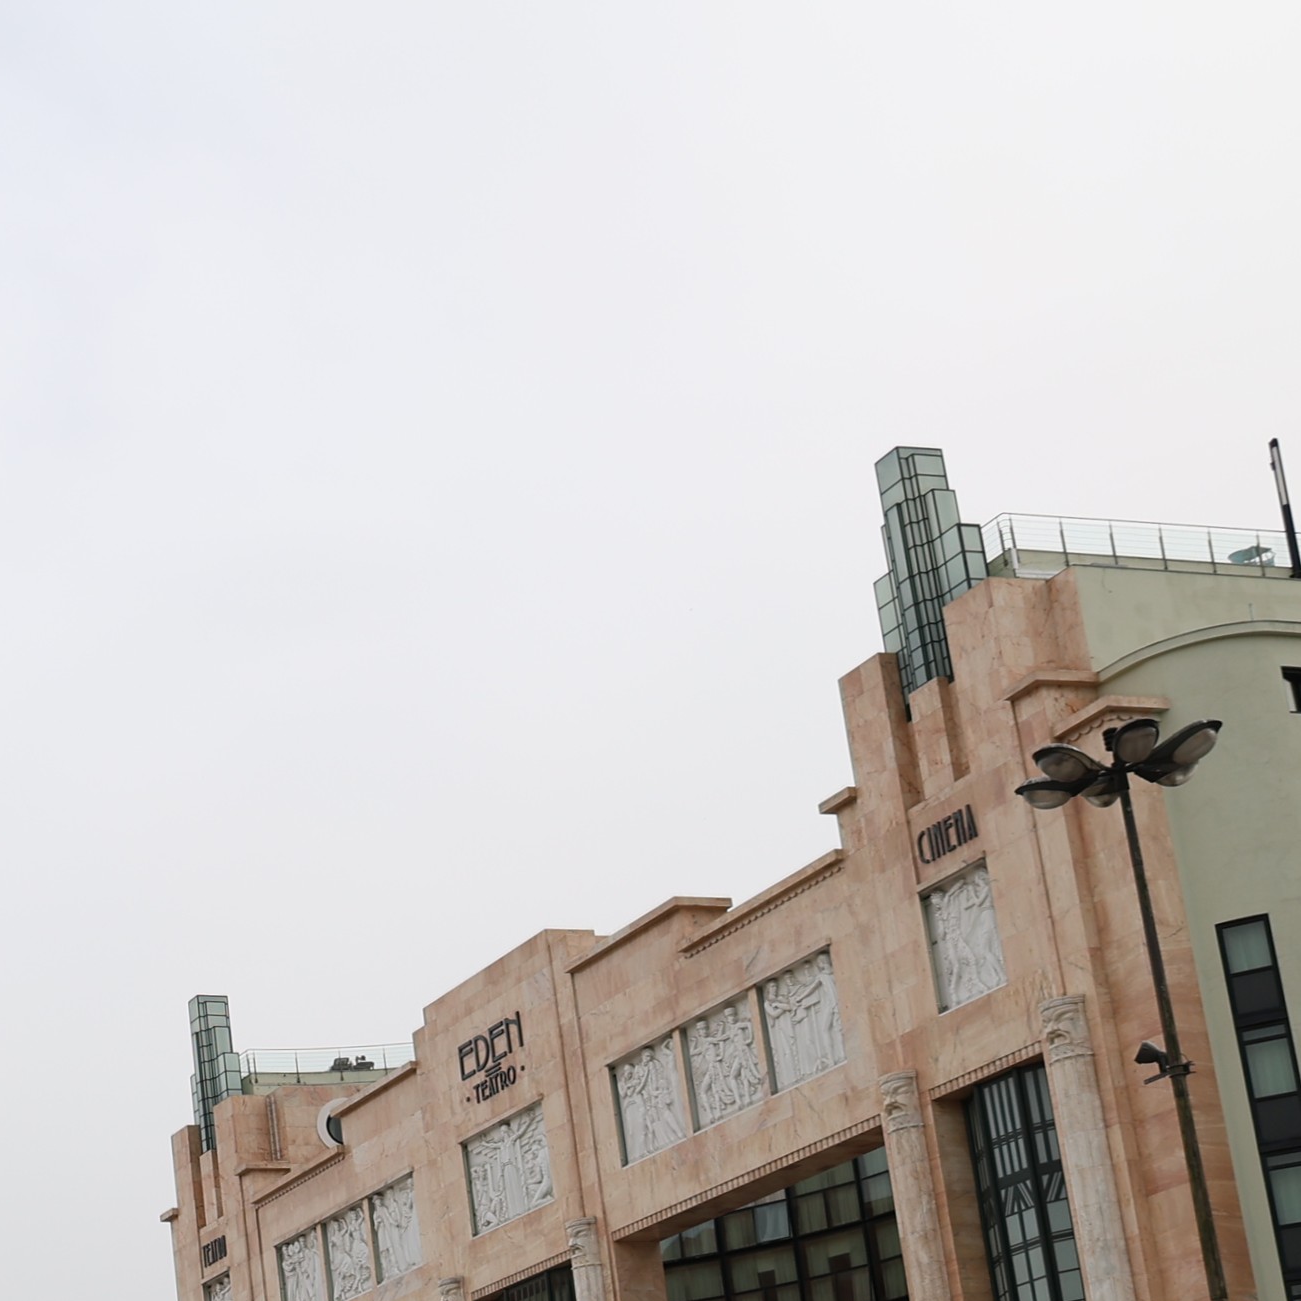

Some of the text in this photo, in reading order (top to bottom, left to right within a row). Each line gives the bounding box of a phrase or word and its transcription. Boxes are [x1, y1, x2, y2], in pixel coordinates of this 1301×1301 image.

[917, 804, 979, 865] CINEMA
[458, 1010, 524, 1081] EDEN
[472, 1065, 517, 1104] TEATRO
[203, 1235, 227, 1268] TEATRO
